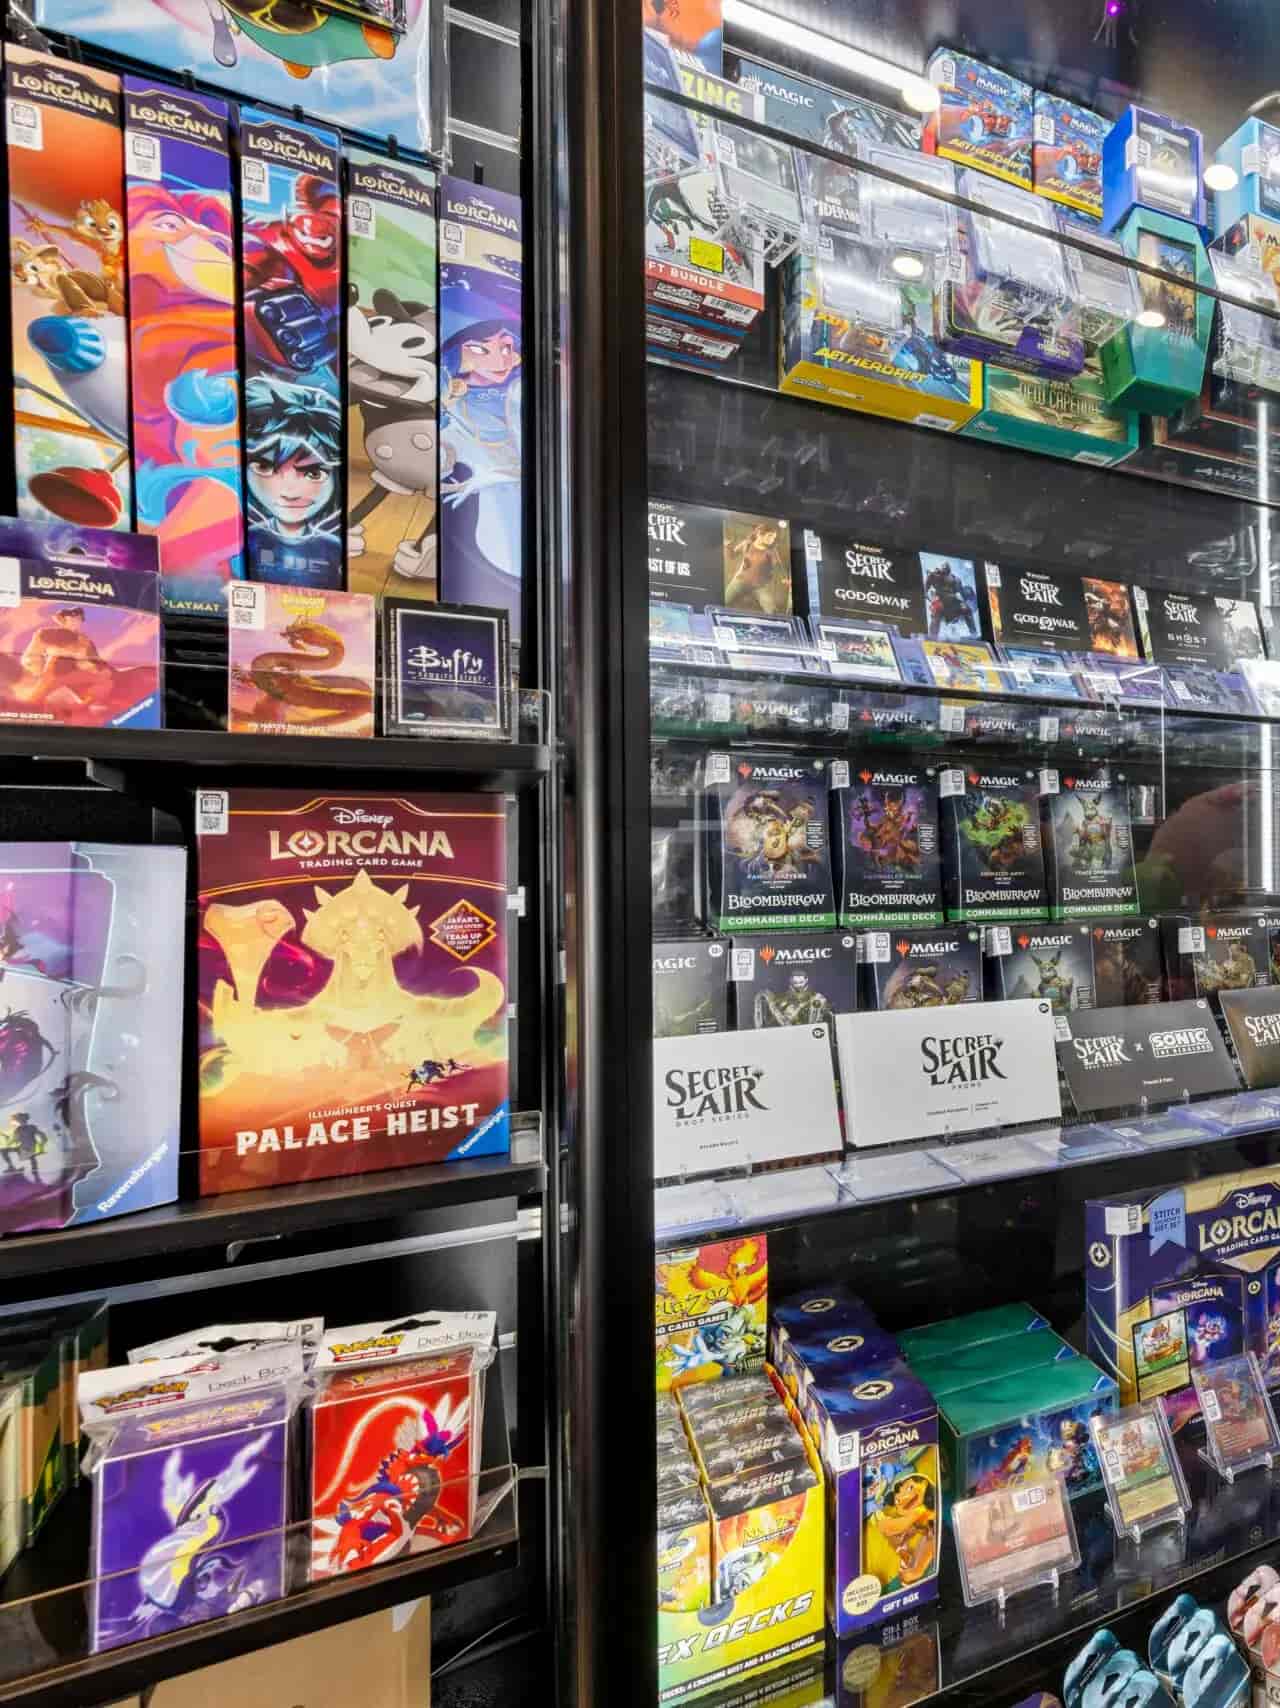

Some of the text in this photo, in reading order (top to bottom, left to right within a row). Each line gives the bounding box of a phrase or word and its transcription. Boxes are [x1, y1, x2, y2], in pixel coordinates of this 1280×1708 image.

[12, 72, 115, 115] LORCANA
[764, 83, 816, 108] MAGIC
[976, 77, 1009, 97] MAGIC
[130, 104, 223, 142] LORCANA
[1071, 119, 1099, 138] MAGIC
[248, 133, 333, 171] LORCANA
[354, 172, 432, 207] LORCANA
[447, 201, 519, 232] LORCANA
[670, 267, 725, 293] BUNDLE
[813, 347, 932, 383] AETHERDRIFT
[845, 550, 893, 570] SECRET
[851, 563, 896, 583] LAIR
[29, 576, 114, 597] LORCANA
[835, 587, 865, 602] GOD
[1020, 577, 1060, 598] SECRET
[1025, 587, 1063, 607] LAIR
[1014, 612, 1079, 631] GOD WAR
[407, 645, 483, 680] Buffy
[752, 766, 803, 780] MAGIC
[873, 773, 917, 785] MAGIC
[980, 775, 1019, 787] MAGIC
[1075, 779, 1111, 790] MAGIC
[269, 830, 455, 860] LORCANA
[300, 858, 424, 868] TRADING CARD GAME
[728, 893, 827, 910] BLOOMBURROW
[848, 892, 937, 908] BLOOMBURROW
[965, 888, 1041, 904] BLOOMBURROW
[1062, 886, 1134, 901] BLOOMBURROW
[849, 912, 937, 923] COMMANDER DECK
[966, 907, 1043, 918] COMMANDER DECK
[1063, 903, 1135, 914] COMMANDER DECK
[728, 914, 826, 926] COMMANDER DECK
[1029, 935, 1072, 947] MAGIC
[1103, 927, 1143, 938] MAGIC
[1216, 927, 1254, 937] MAGIC
[774, 947, 833, 961] MAGIC
[910, 941, 960, 954] MAGIC
[1073, 1034, 1120, 1059] SECRET
[1151, 1030, 1208, 1047] SONIC
[920, 1034, 993, 1074] SECRET
[1083, 1041, 1133, 1067] LAIR
[930, 1046, 1009, 1086] LAIR
[665, 1064, 751, 1107] SECRET
[675, 1077, 770, 1120] LAIR
[308, 1100, 417, 1120] ILLUMINEER'S QUEST
[236, 1103, 481, 1156] PALACE HEIST
[1154, 1207, 1181, 1219] STITCH
[1217, 1240, 1249, 1255] TRADING
[1250, 1235, 1270, 1245] CARD
[1177, 1287, 1224, 1303] LORCANA
[668, 1314, 727, 1332] CARD GAME
[418, 1334, 453, 1349] Deck
[861, 1429, 920, 1457] LORCANA
[882, 1598, 901, 1613] GIFT
[902, 1591, 920, 1606] BOX
[702, 1591, 814, 1651] DECKS
